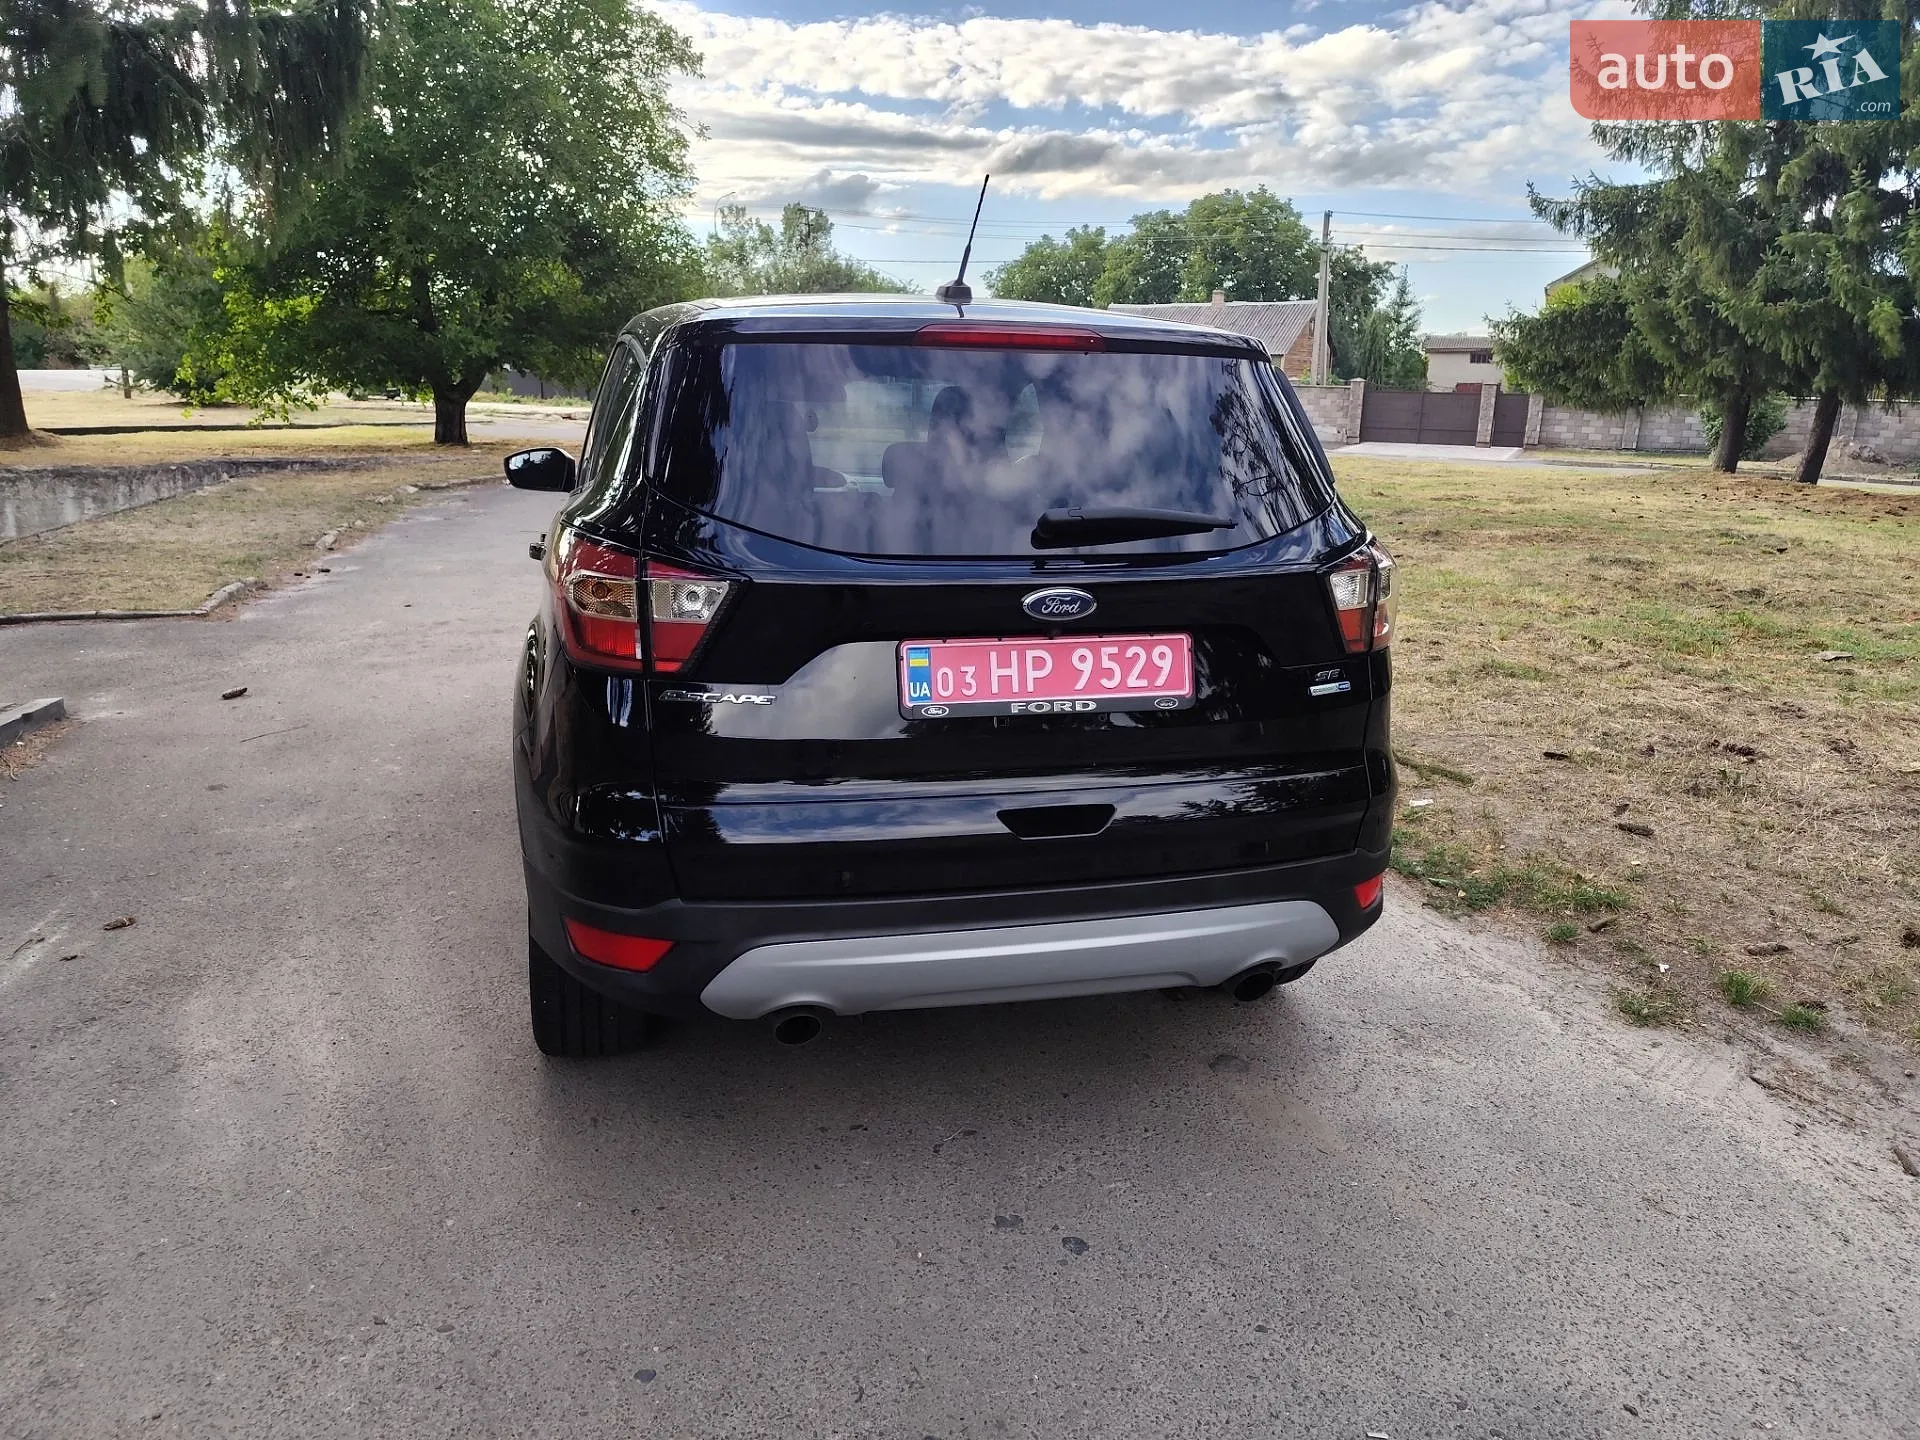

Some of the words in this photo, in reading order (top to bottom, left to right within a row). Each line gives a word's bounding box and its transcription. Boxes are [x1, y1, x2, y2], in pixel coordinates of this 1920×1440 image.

[1041, 596, 1081, 614] Ford
[936, 666, 977, 698] 03
[989, 649, 1053, 694] HP
[1071, 645, 1173, 691] 9529
[659, 689, 777, 705] ESCAPE
[910, 681, 931, 698] UA
[1011, 700, 1097, 714] FORD
